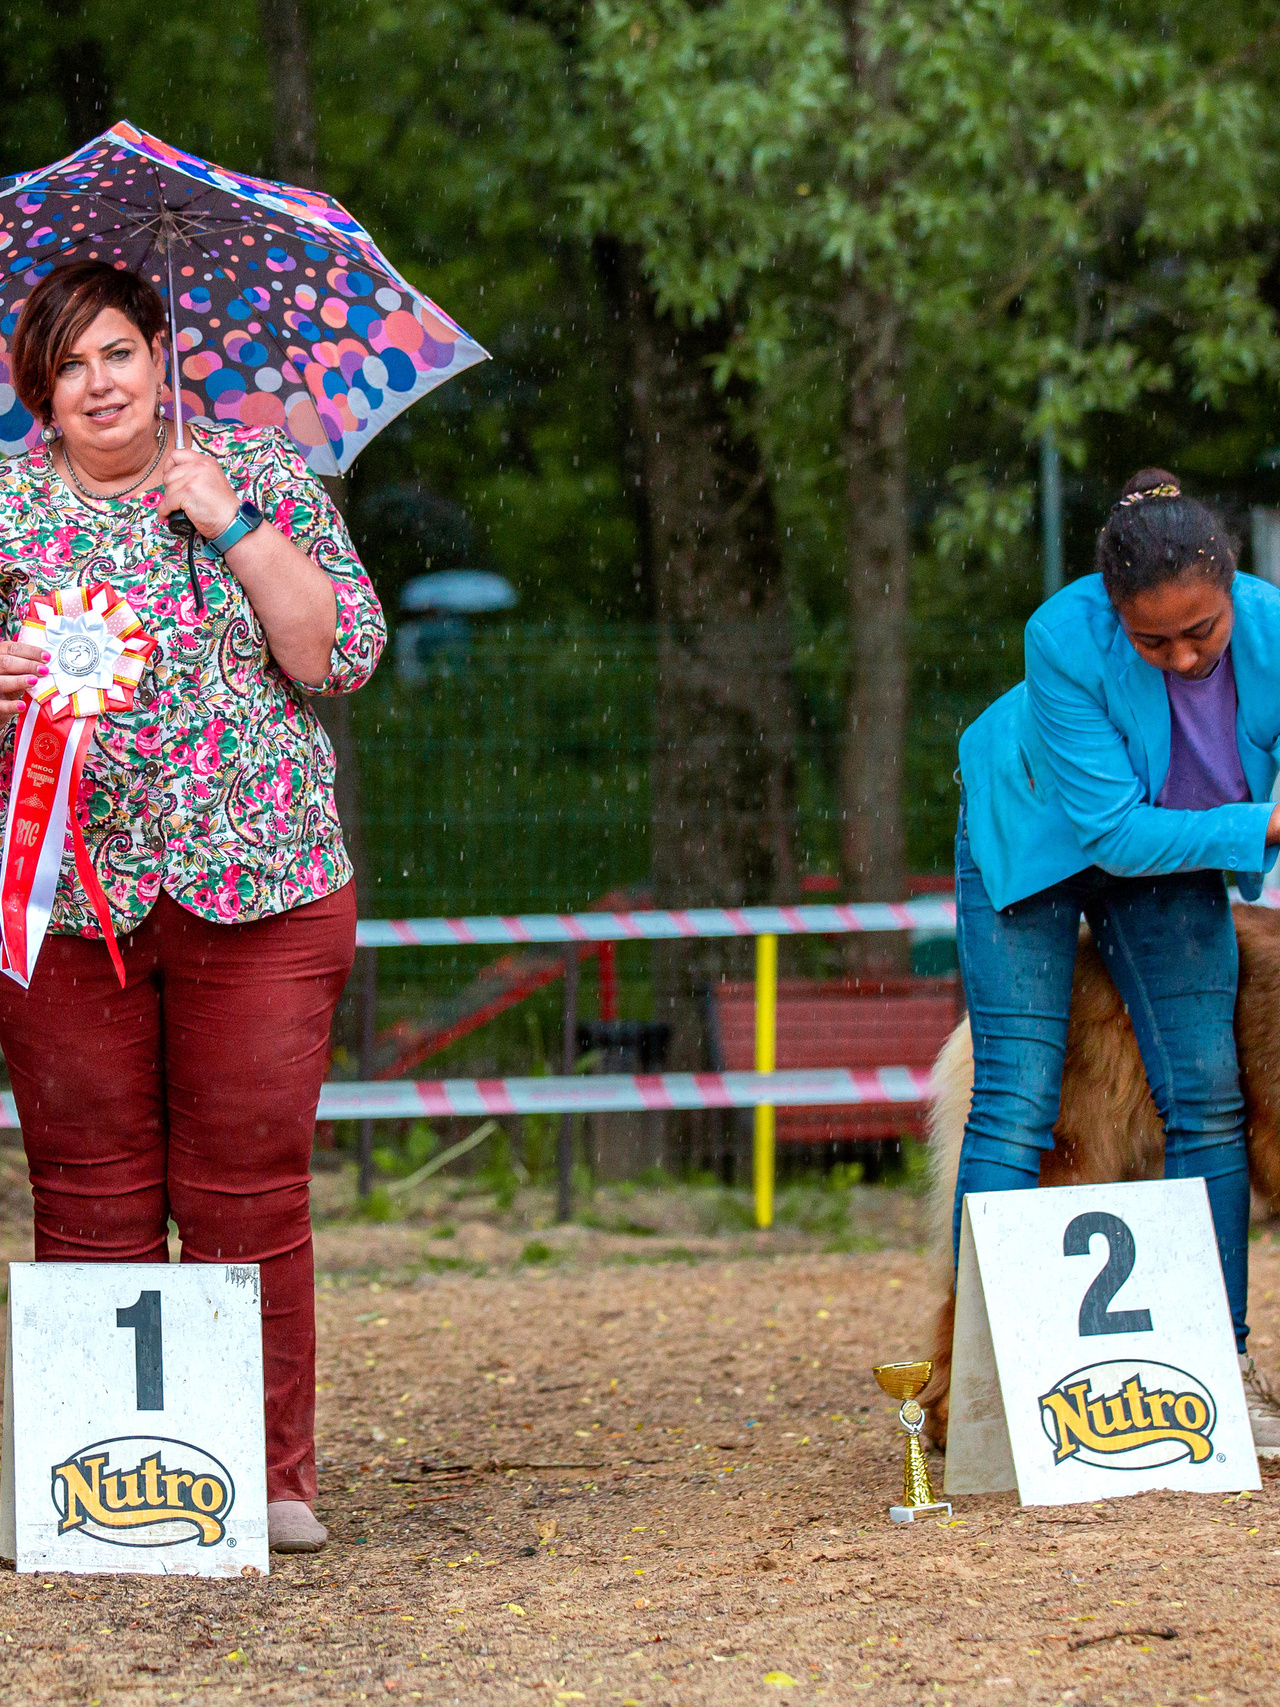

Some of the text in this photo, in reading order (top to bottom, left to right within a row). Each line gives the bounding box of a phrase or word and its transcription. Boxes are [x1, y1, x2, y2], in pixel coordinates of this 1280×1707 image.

[14, 856, 25, 881] 1
[1062, 1210, 1154, 1337] 2
[116, 1290, 164, 1411] 1
[1038, 1372, 1214, 1466] Nutro
[51, 1450, 228, 1546] Nutro
